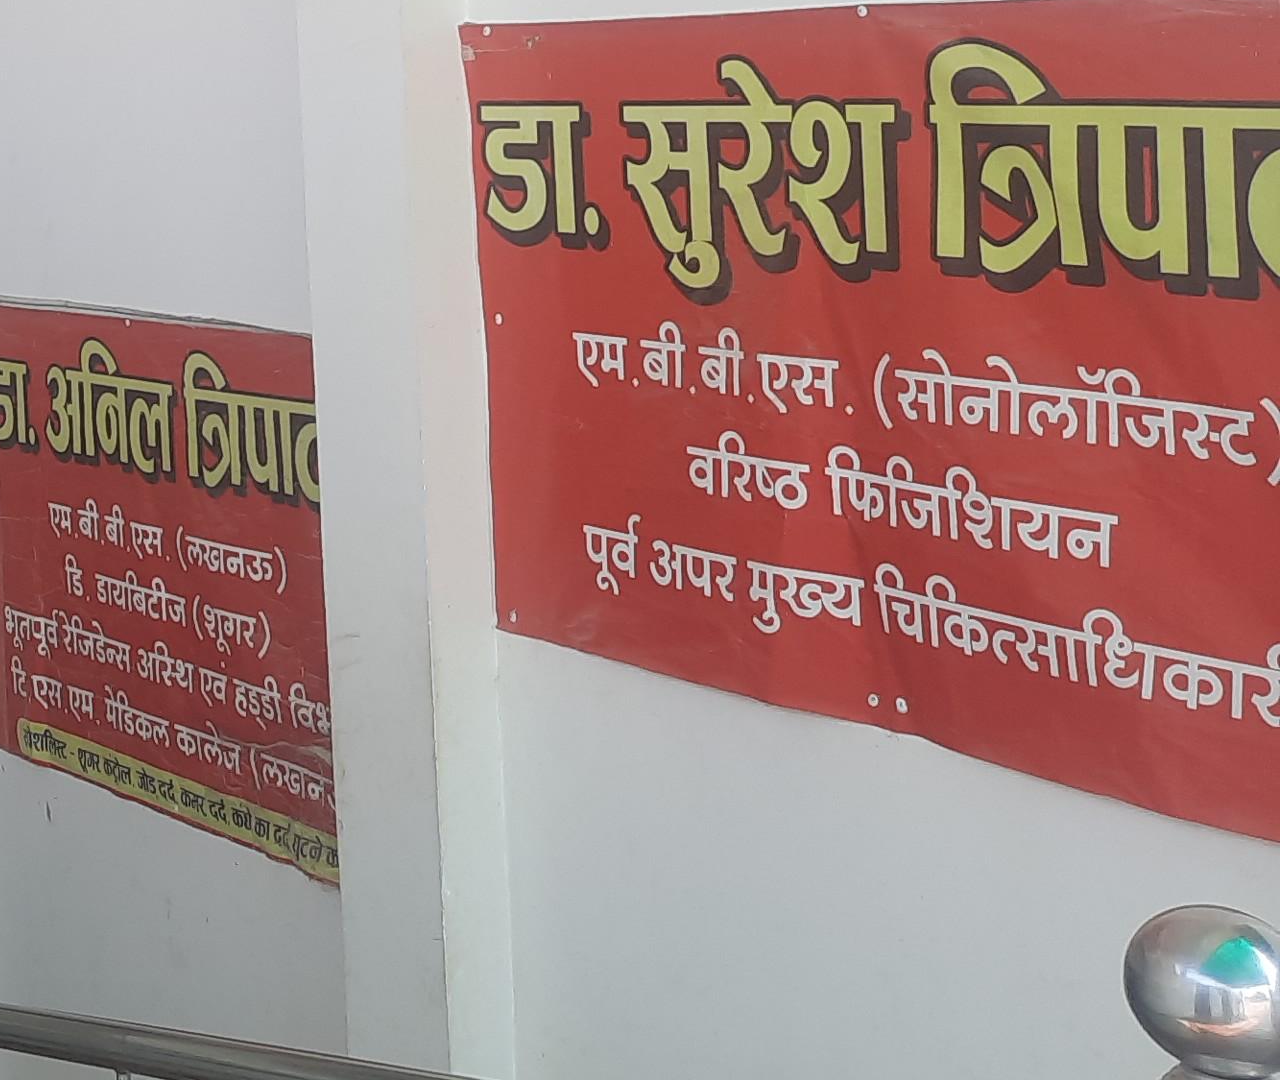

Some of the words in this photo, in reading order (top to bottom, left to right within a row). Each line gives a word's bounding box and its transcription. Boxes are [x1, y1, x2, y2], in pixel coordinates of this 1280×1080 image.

[480, 100, 603, 240] डा.
[620, 54, 904, 292] सुरेश
[926, 36, 1280, 282] त्रिपा
[45, 339, 174, 474] अनिल
[686, 431, 810, 511] वरिष्ठ
[824, 444, 1119, 569] फिजिशियन
[95, 570, 187, 628] डायबिटीज
[583, 513, 640, 597] पूर्व
[650, 539, 735, 603] अपर
[748, 562, 865, 636] मुख्य
